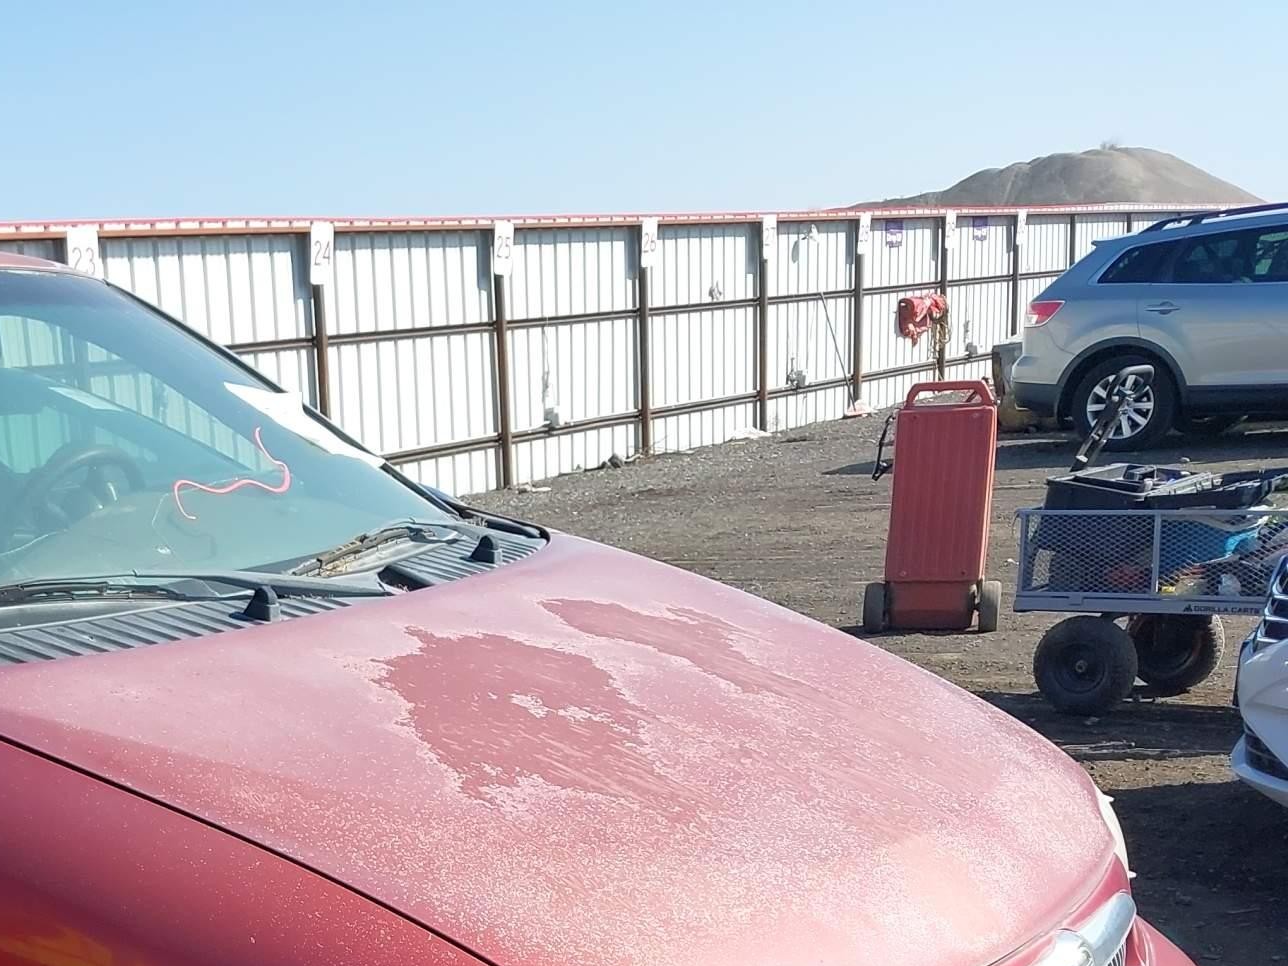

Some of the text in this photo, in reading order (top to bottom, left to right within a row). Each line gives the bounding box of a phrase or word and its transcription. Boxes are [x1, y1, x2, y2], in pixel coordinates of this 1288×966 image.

[313, 240, 331, 266] 24
[496, 235, 511, 260] 25
[643, 232, 657, 253] 26
[72, 246, 96, 275] 23
[1193, 605, 1229, 613] GORILLA
